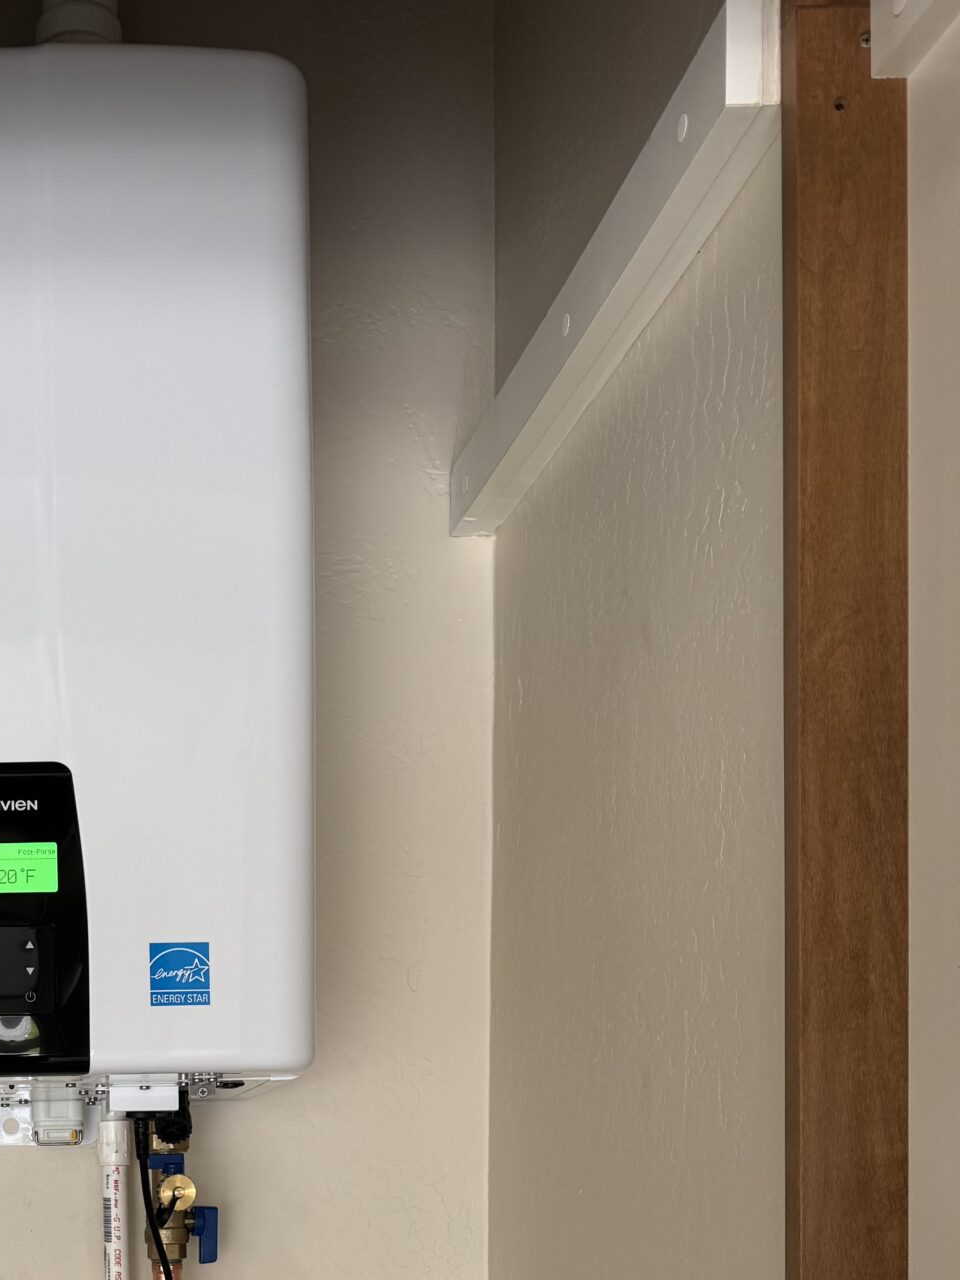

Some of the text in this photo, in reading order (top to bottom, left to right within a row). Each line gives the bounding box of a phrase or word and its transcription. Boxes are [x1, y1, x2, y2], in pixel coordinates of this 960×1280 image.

[152, 993, 208, 1004] ENERGY STAR
[113, 1249, 122, 1268] CODE
